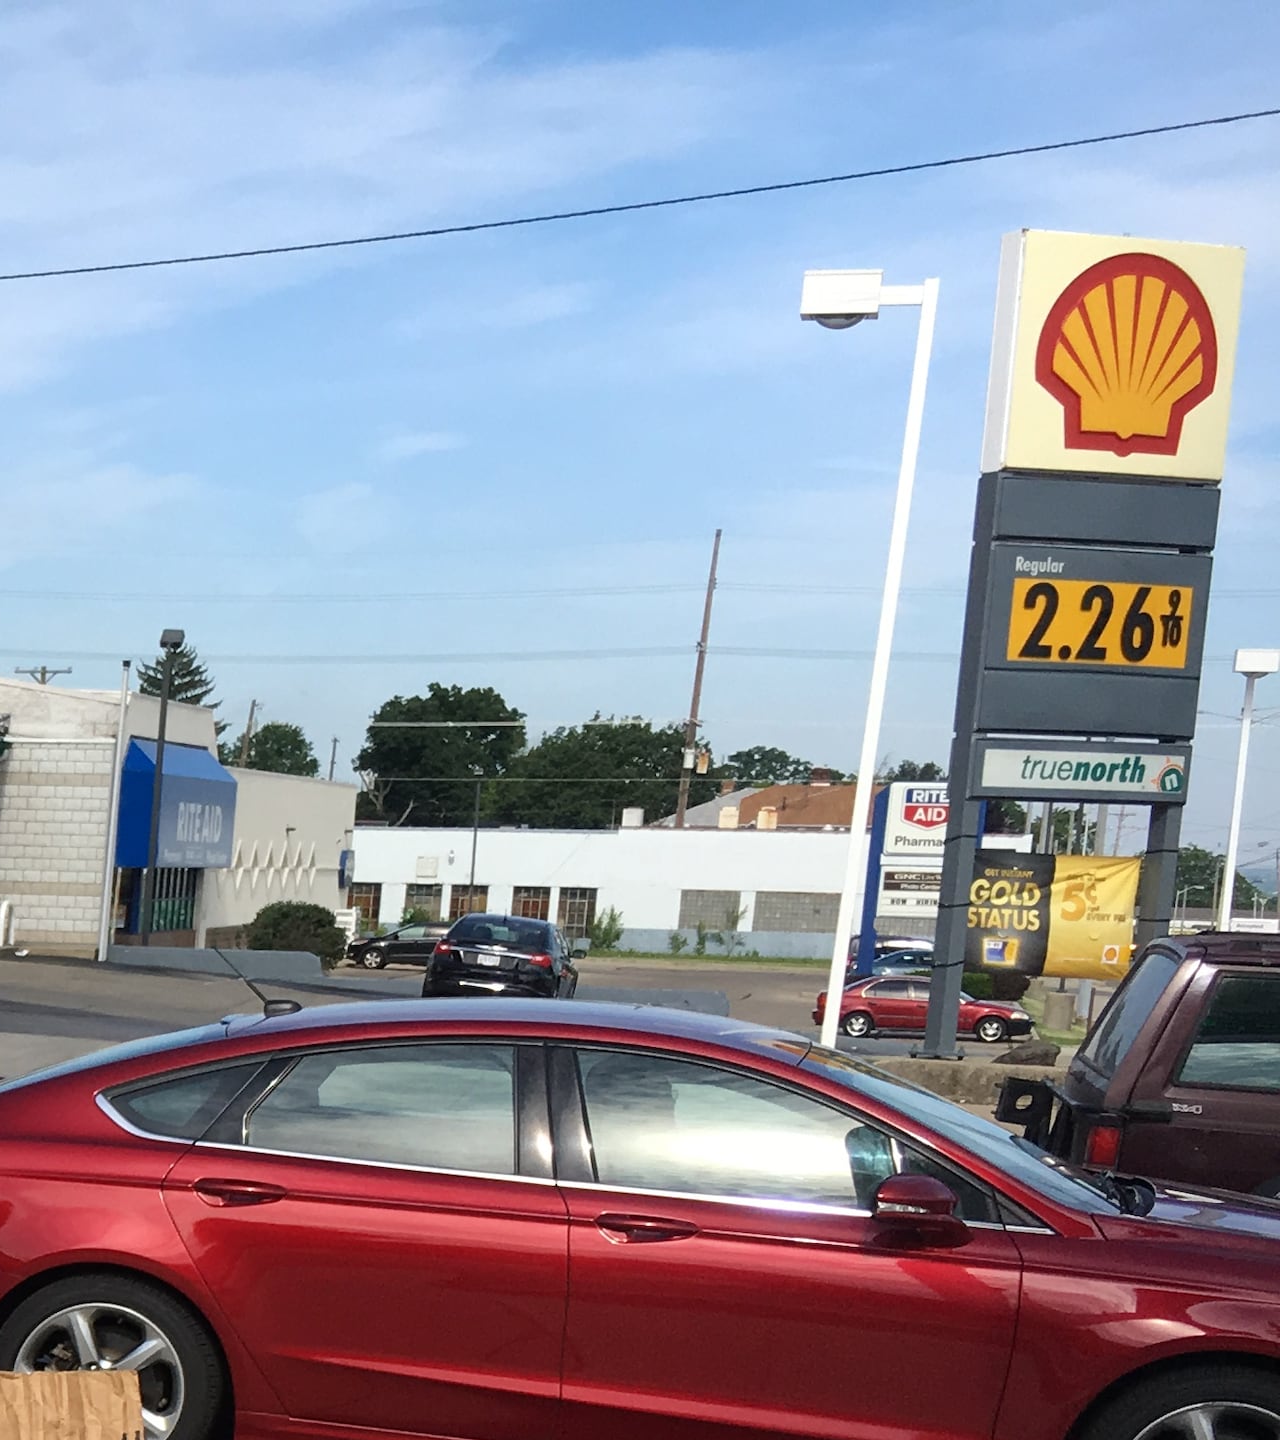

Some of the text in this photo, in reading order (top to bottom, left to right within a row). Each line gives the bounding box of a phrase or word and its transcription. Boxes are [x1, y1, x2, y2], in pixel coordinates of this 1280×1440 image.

[1014, 555, 1065, 576] Regular
[1018, 582, 1155, 663] 2.26
[1020, 755, 1146, 784] truenorth
[911, 789, 949, 803] RITE
[176, 801, 224, 844] RITE AID
[912, 806, 947, 822] AID
[894, 835, 943, 847] Pharma
[894, 873, 921, 881] GNC
[915, 898, 939, 906] HIRIN
[969, 878, 1042, 907] GOLD
[967, 906, 1041, 932] STATUS
